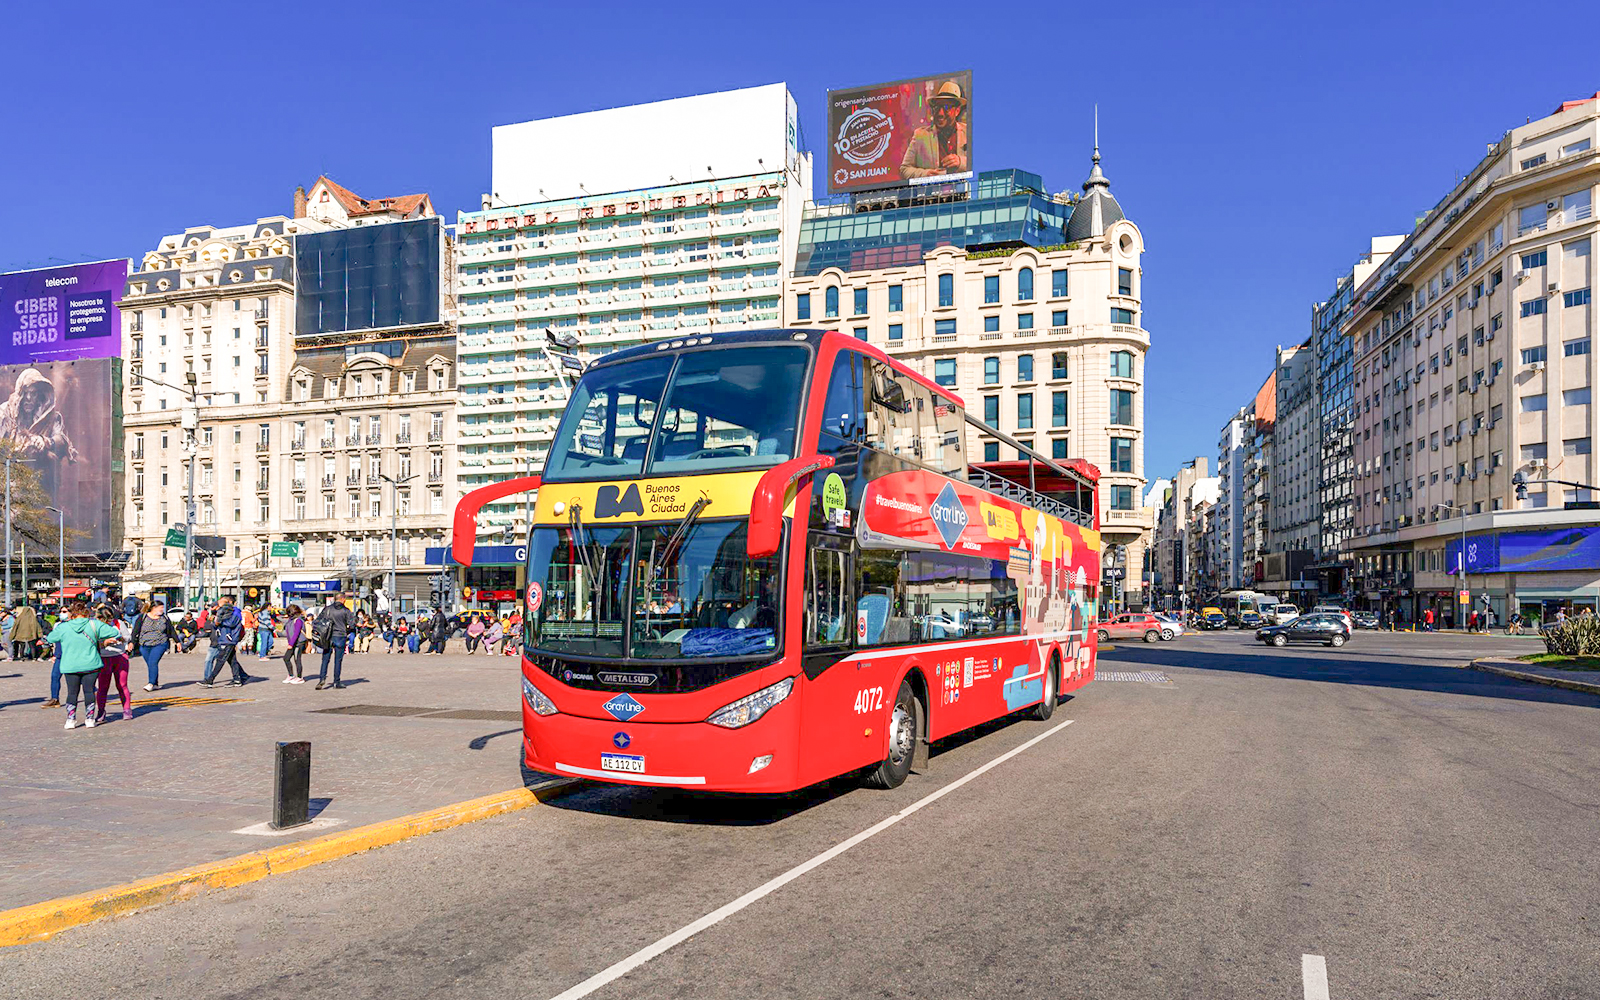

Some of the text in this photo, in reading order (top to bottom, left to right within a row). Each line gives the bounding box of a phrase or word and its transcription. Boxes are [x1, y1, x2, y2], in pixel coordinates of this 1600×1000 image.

[834, 92, 899, 108] origensanjuan.com.ar
[849, 167, 888, 179] SAN JUAN
[465, 185, 771, 234] HOTEL REPUBLICA
[45, 276, 78, 288] telecom
[14, 296, 58, 315] CIBER
[69, 298, 104, 308] Nosotros te
[69, 307, 107, 317] protegemos,
[20, 312, 58, 330] SEGU
[69, 315, 103, 325] tu empresa
[69, 325, 87, 333] crece
[12, 328, 58, 346] RIDAD
[645, 484, 681, 494] Buenos
[828, 484, 840, 495] Safe
[649, 494, 676, 503] Aires
[826, 495, 844, 506] travels
[875, 494, 923, 514] #travelbuenosaires
[651, 503, 686, 513] Ciudad
[33, 581, 50, 589] ALMA
[572, 673, 594, 681] SCANIA
[604, 674, 650, 684] METALSUR
[853, 686, 883, 714] 4072
[603, 758, 642, 771] AE 112 CY
